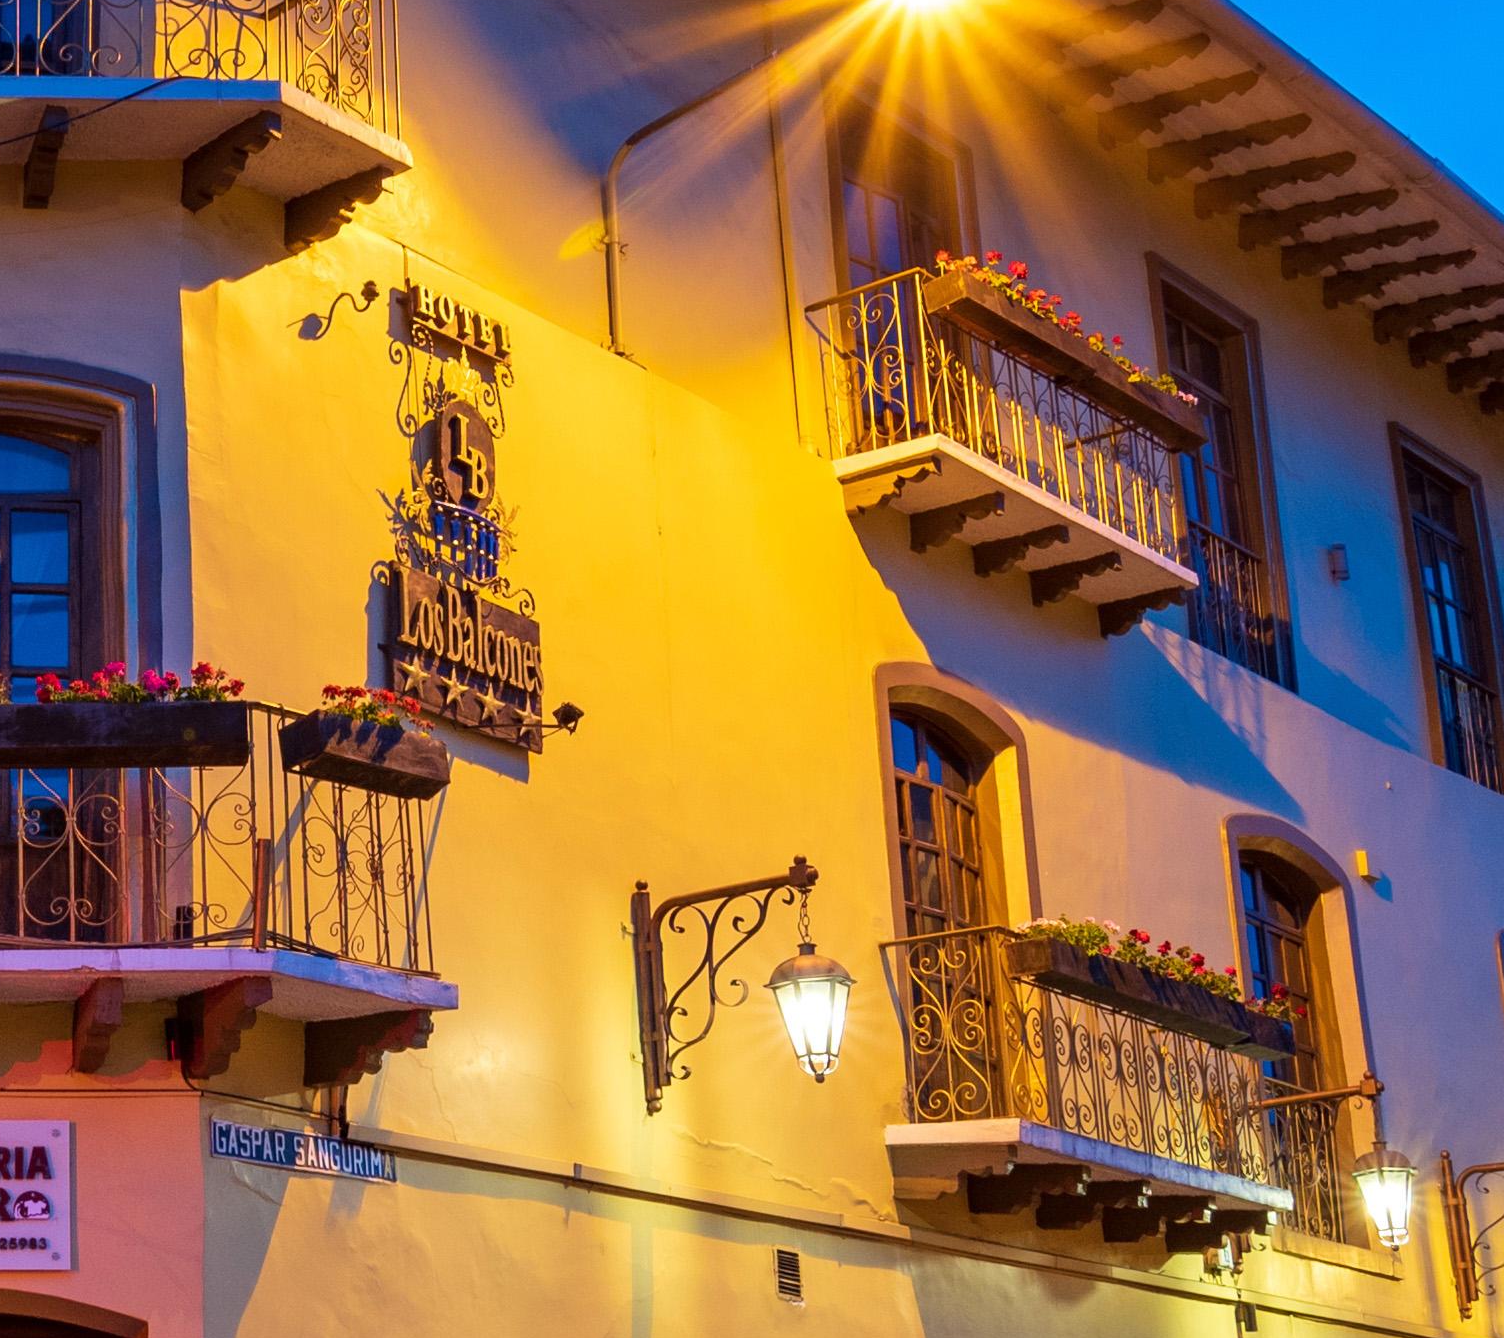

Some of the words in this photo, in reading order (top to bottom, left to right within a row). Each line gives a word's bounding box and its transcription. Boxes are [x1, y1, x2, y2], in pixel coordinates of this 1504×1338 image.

[416, 284, 511, 356] HOTEL
[455, 412, 489, 500] LB
[398, 564, 444, 657] Los
[445, 580, 544, 696] Balcones
[214, 1123, 287, 1163] GASPAR
[292, 1136, 394, 1179] SANGURIMA
